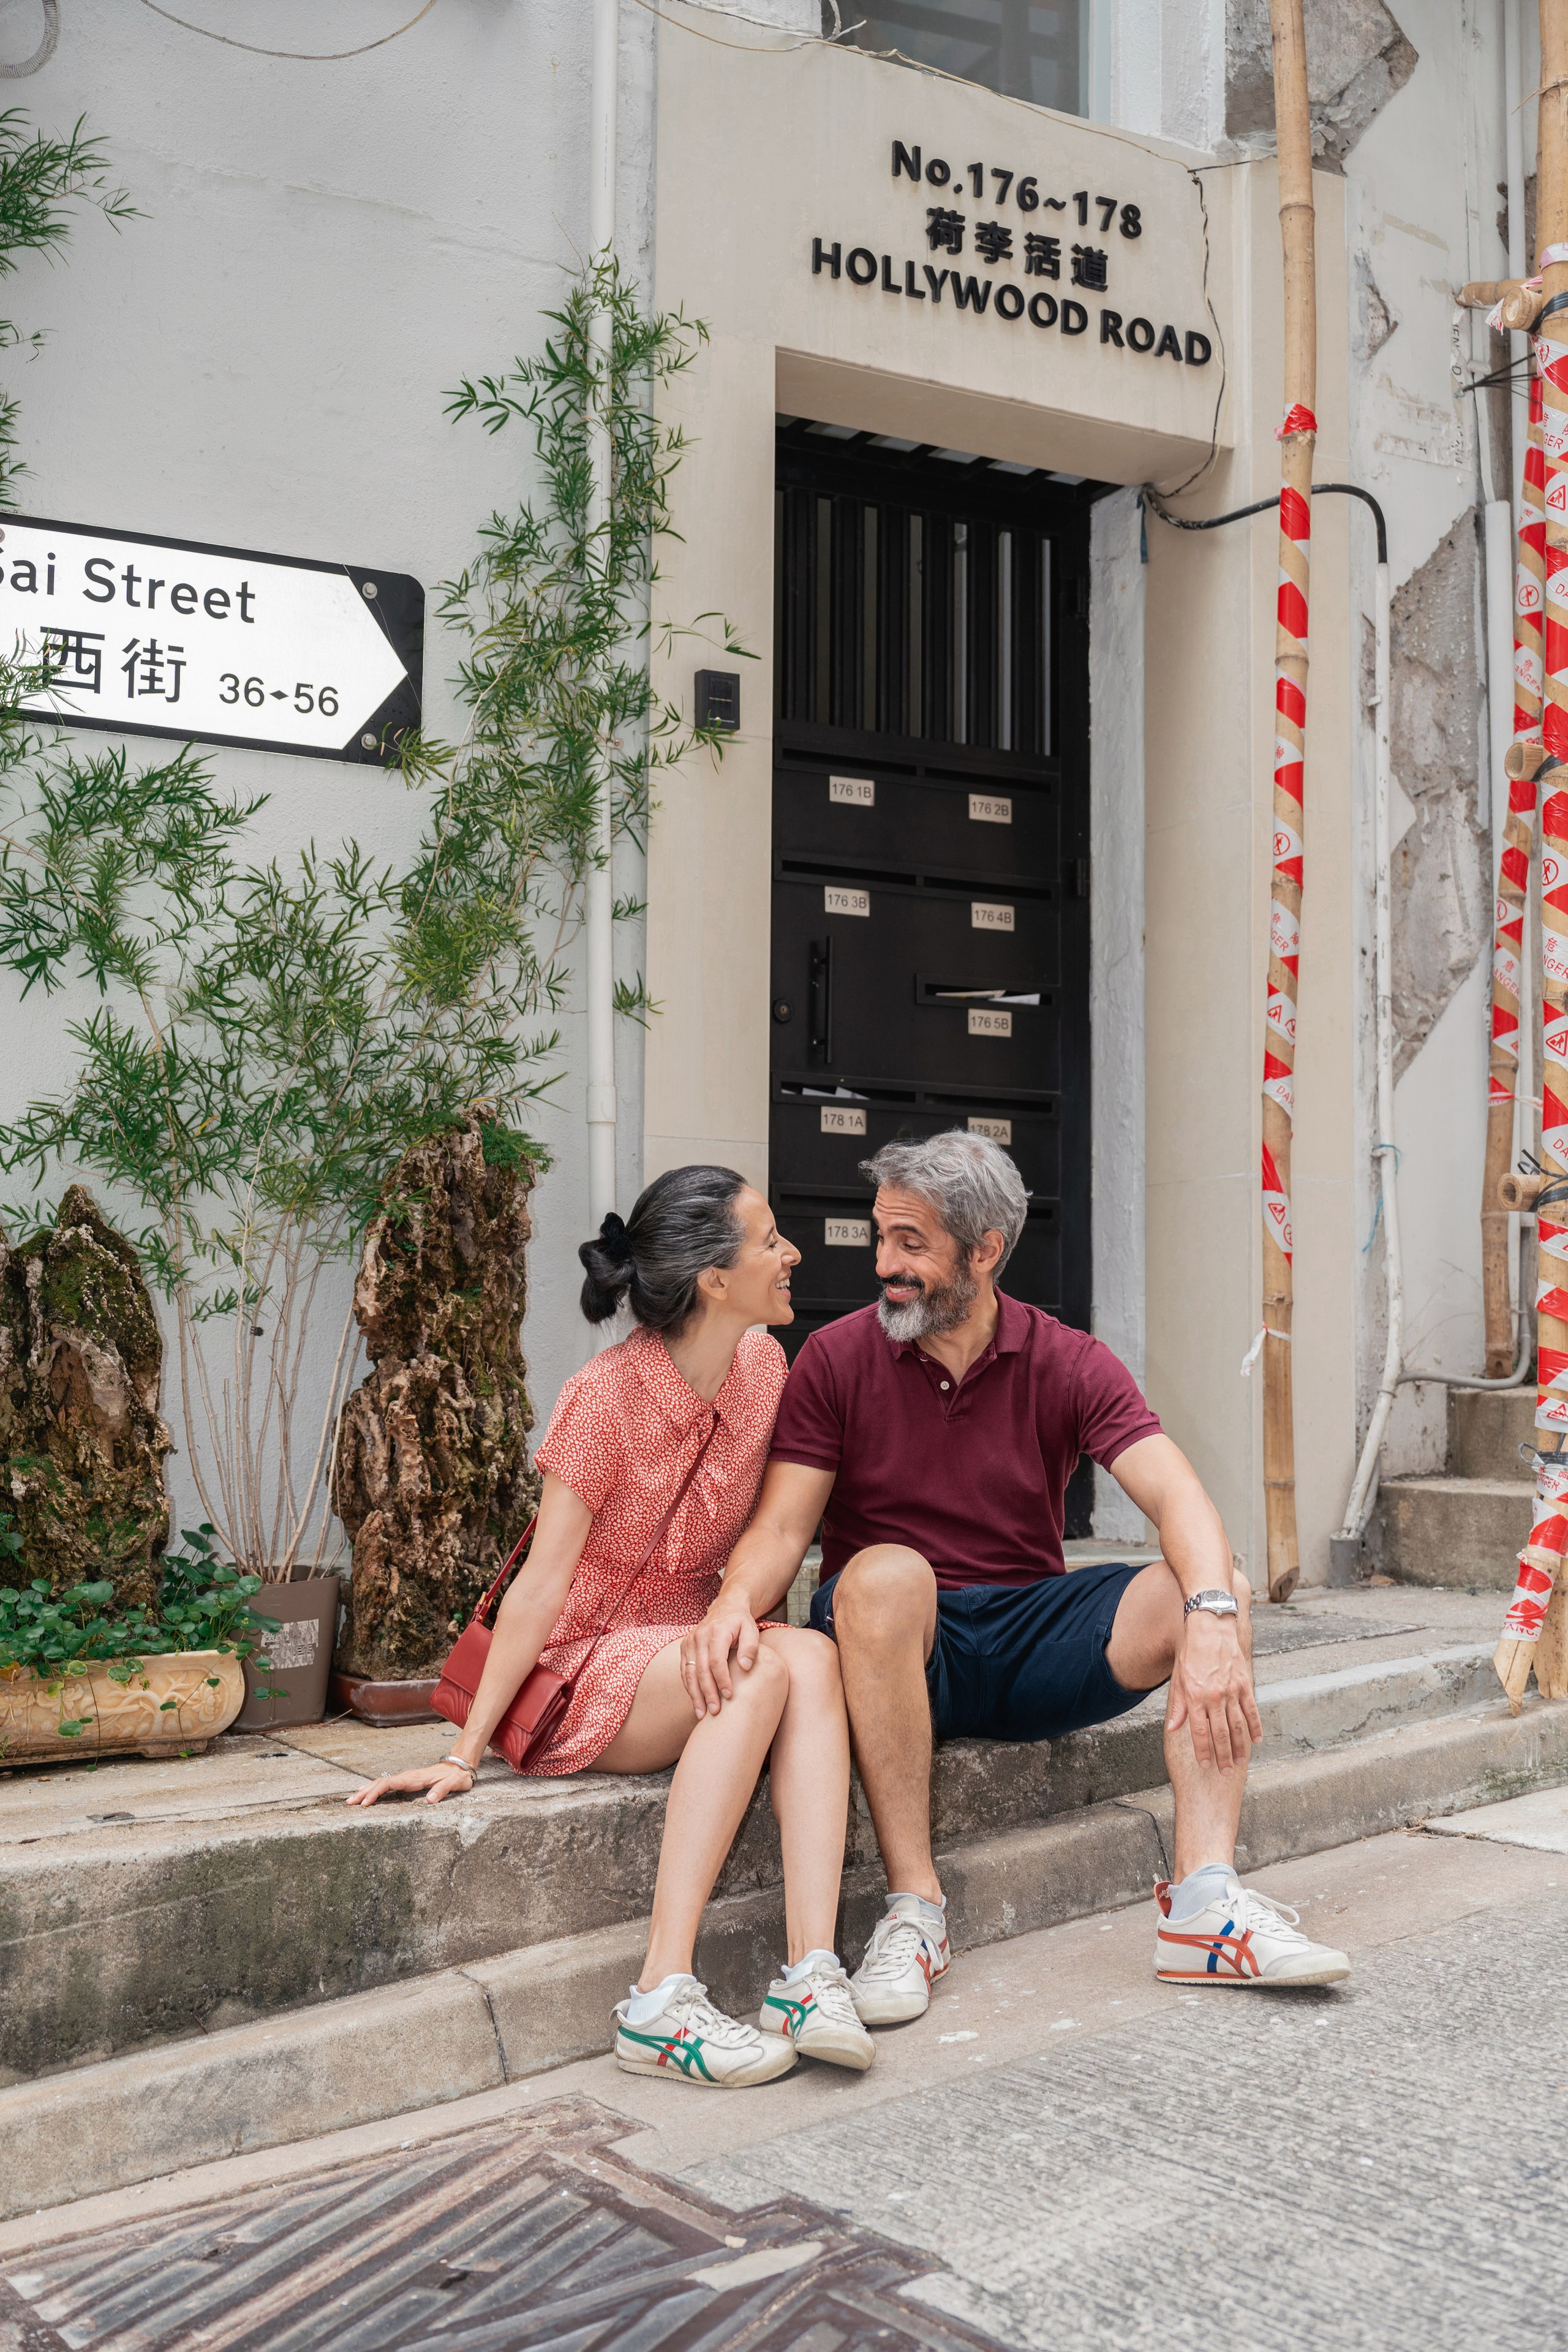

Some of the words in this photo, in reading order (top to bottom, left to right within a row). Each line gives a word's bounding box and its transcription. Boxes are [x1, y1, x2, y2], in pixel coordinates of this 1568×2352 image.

[925, 206, 1109, 293] 荷李活道
[812, 237, 1088, 336] HOLLYWOOD
[1100, 309, 1212, 367] ROAD
[0, 547, 56, 595] ai
[83, 558, 255, 624] Street
[40, 626, 187, 703] 西街
[832, 783, 854, 796] 176
[857, 786, 872, 798] 1B
[971, 801, 992, 815] 176
[994, 804, 1009, 816] 2B
[827, 894, 848, 907] 176
[851, 896, 867, 908] 3B
[974, 910, 994, 922] 176
[997, 911, 1012, 924] 4B
[971, 1016, 991, 1028] 176
[994, 1017, 1009, 1030] 5B
[823, 1113, 844, 1126] 178
[848, 1115, 864, 1128] 1A
[971, 1124, 990, 1136] 178
[993, 1126, 1009, 1138] 2A
[827, 1226, 848, 1238] 178
[852, 1226, 869, 1239] 3A
